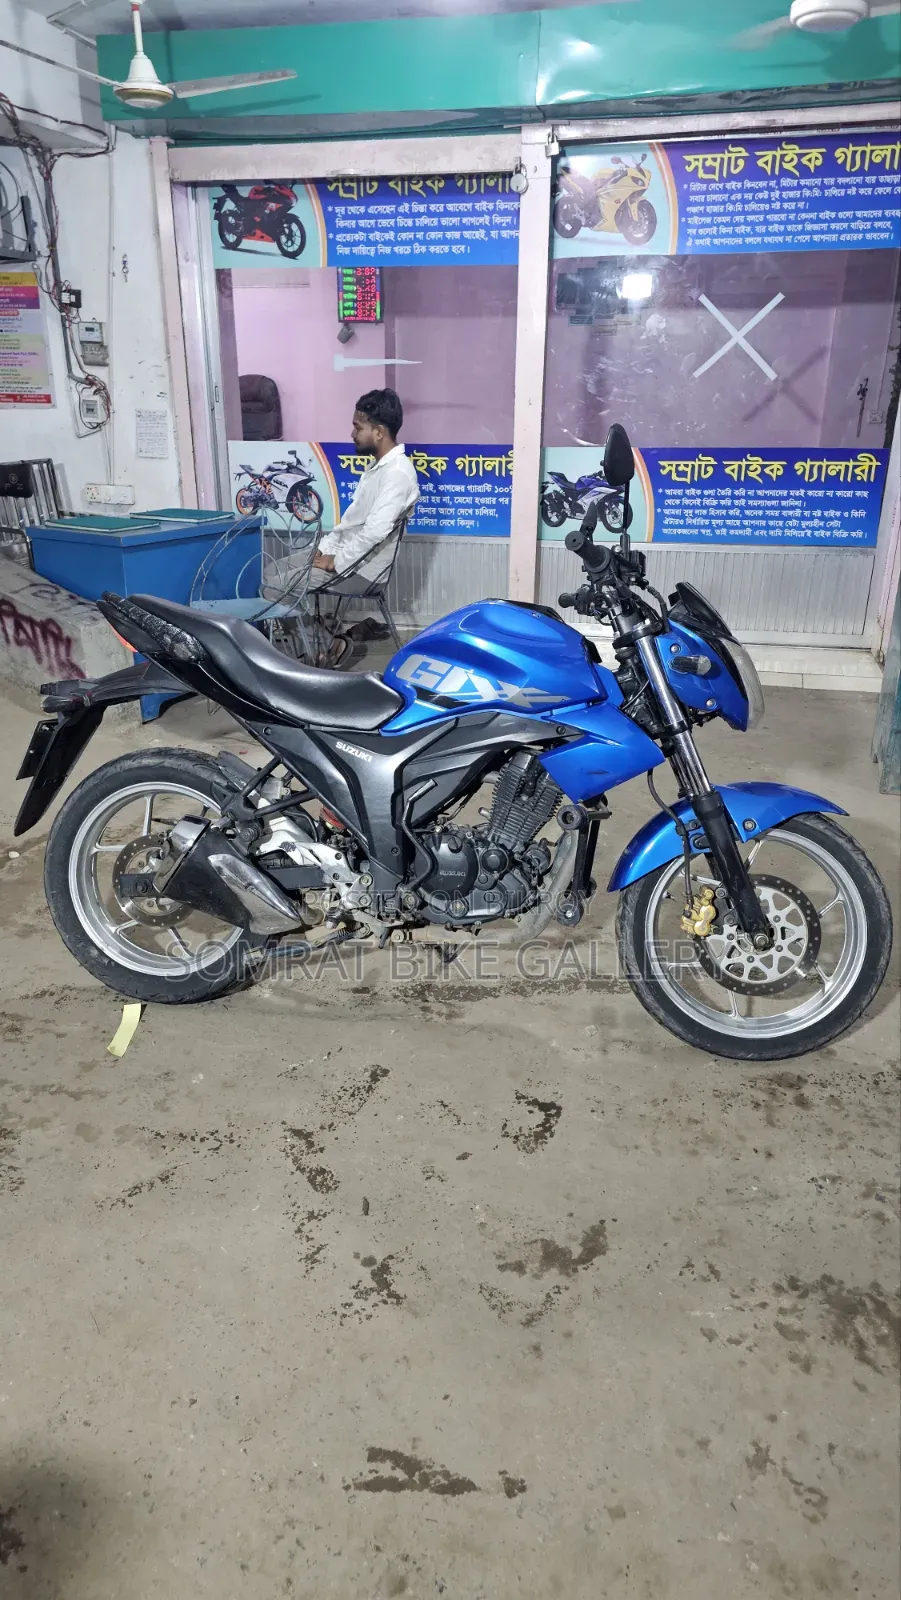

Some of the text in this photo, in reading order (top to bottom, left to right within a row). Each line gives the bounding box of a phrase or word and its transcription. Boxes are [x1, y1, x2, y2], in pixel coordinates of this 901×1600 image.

[682, 143, 749, 182] সম্রাট
[754, 141, 827, 177] বাইক
[658, 452, 880, 484] সম্রাট বাইক গ্যালারী
[335, 741, 374, 763] SUZUKI
